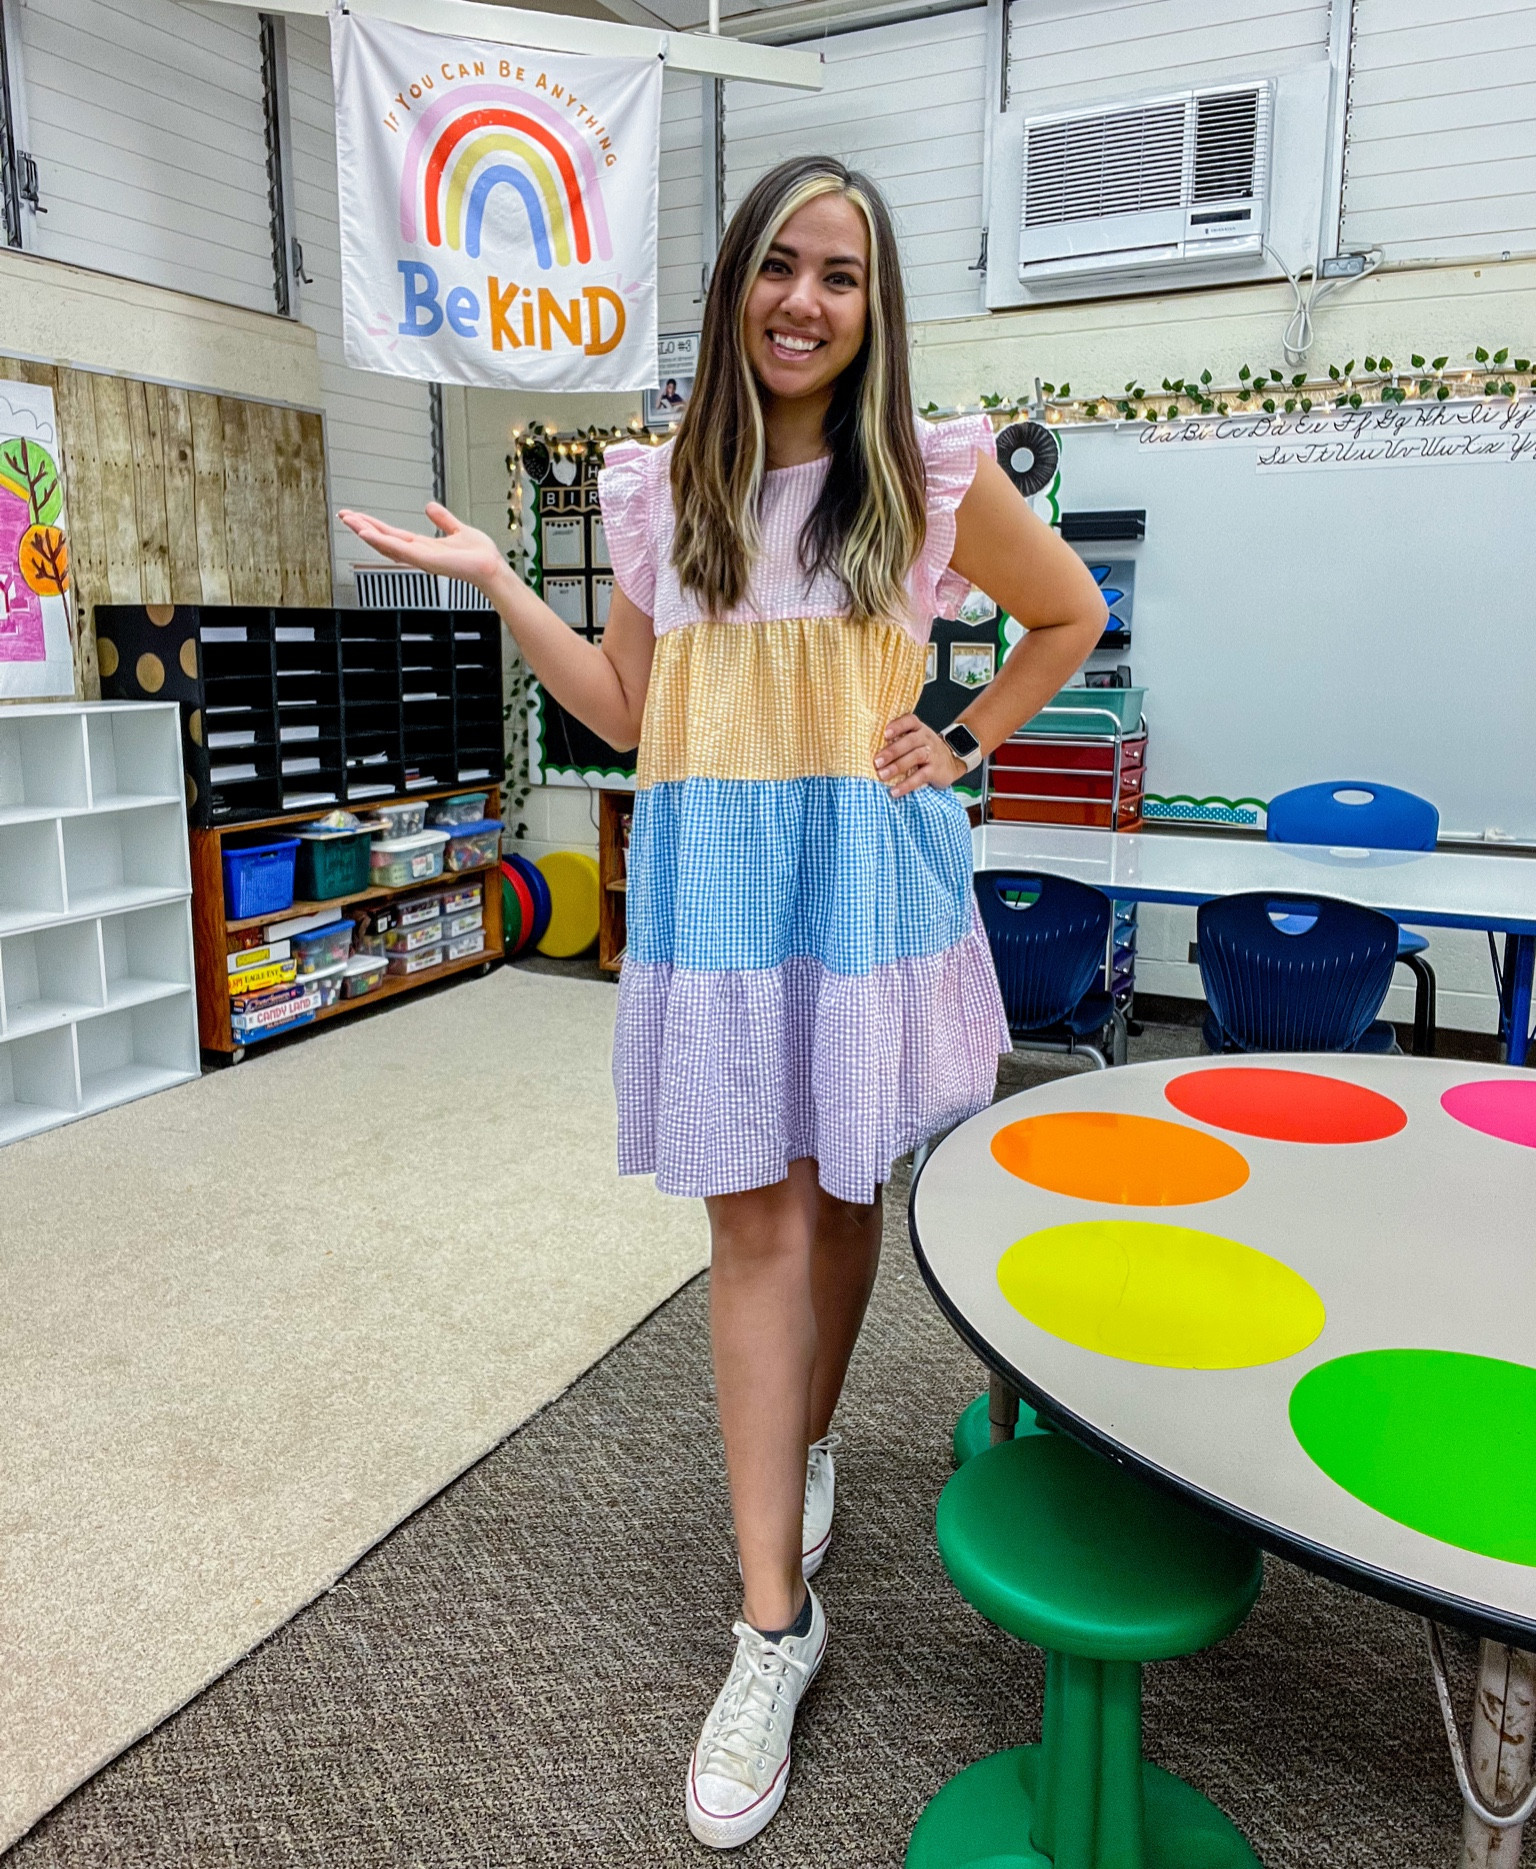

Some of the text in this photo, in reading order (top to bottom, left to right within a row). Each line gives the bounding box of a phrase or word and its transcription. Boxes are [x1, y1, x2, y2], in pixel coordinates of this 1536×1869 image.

[383, 60, 617, 167] IF YOU CAN BE ANYTHING
[397, 259, 481, 338] Be
[677, 339, 692, 352] #3
[257, 1005, 287, 1024] CANDY
[289, 998, 311, 1013] LAND
